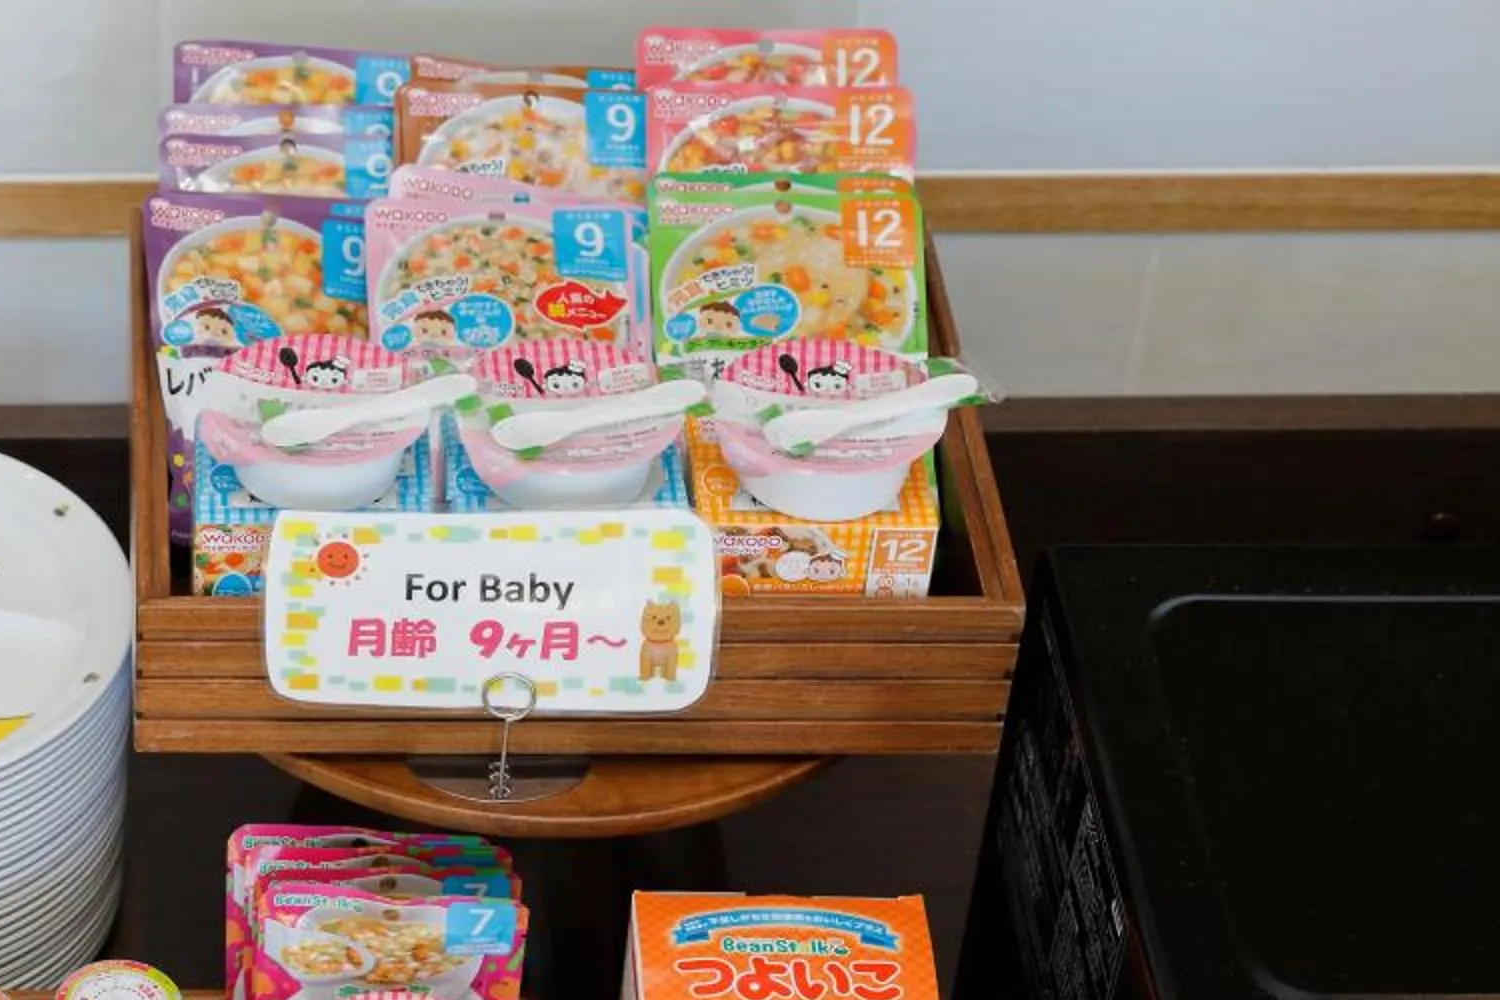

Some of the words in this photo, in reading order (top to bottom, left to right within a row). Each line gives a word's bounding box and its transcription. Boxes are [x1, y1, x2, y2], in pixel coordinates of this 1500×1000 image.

[606, 104, 636, 143] 9
[850, 105, 895, 146] 12
[574, 222, 605, 258] 9
[856, 208, 902, 248] 12
[882, 538, 928, 563] 12
[405, 574, 467, 604] For
[479, 573, 575, 610] Baby
[348, 617, 437, 660] 月齢
[468, 908, 495, 937] 7
